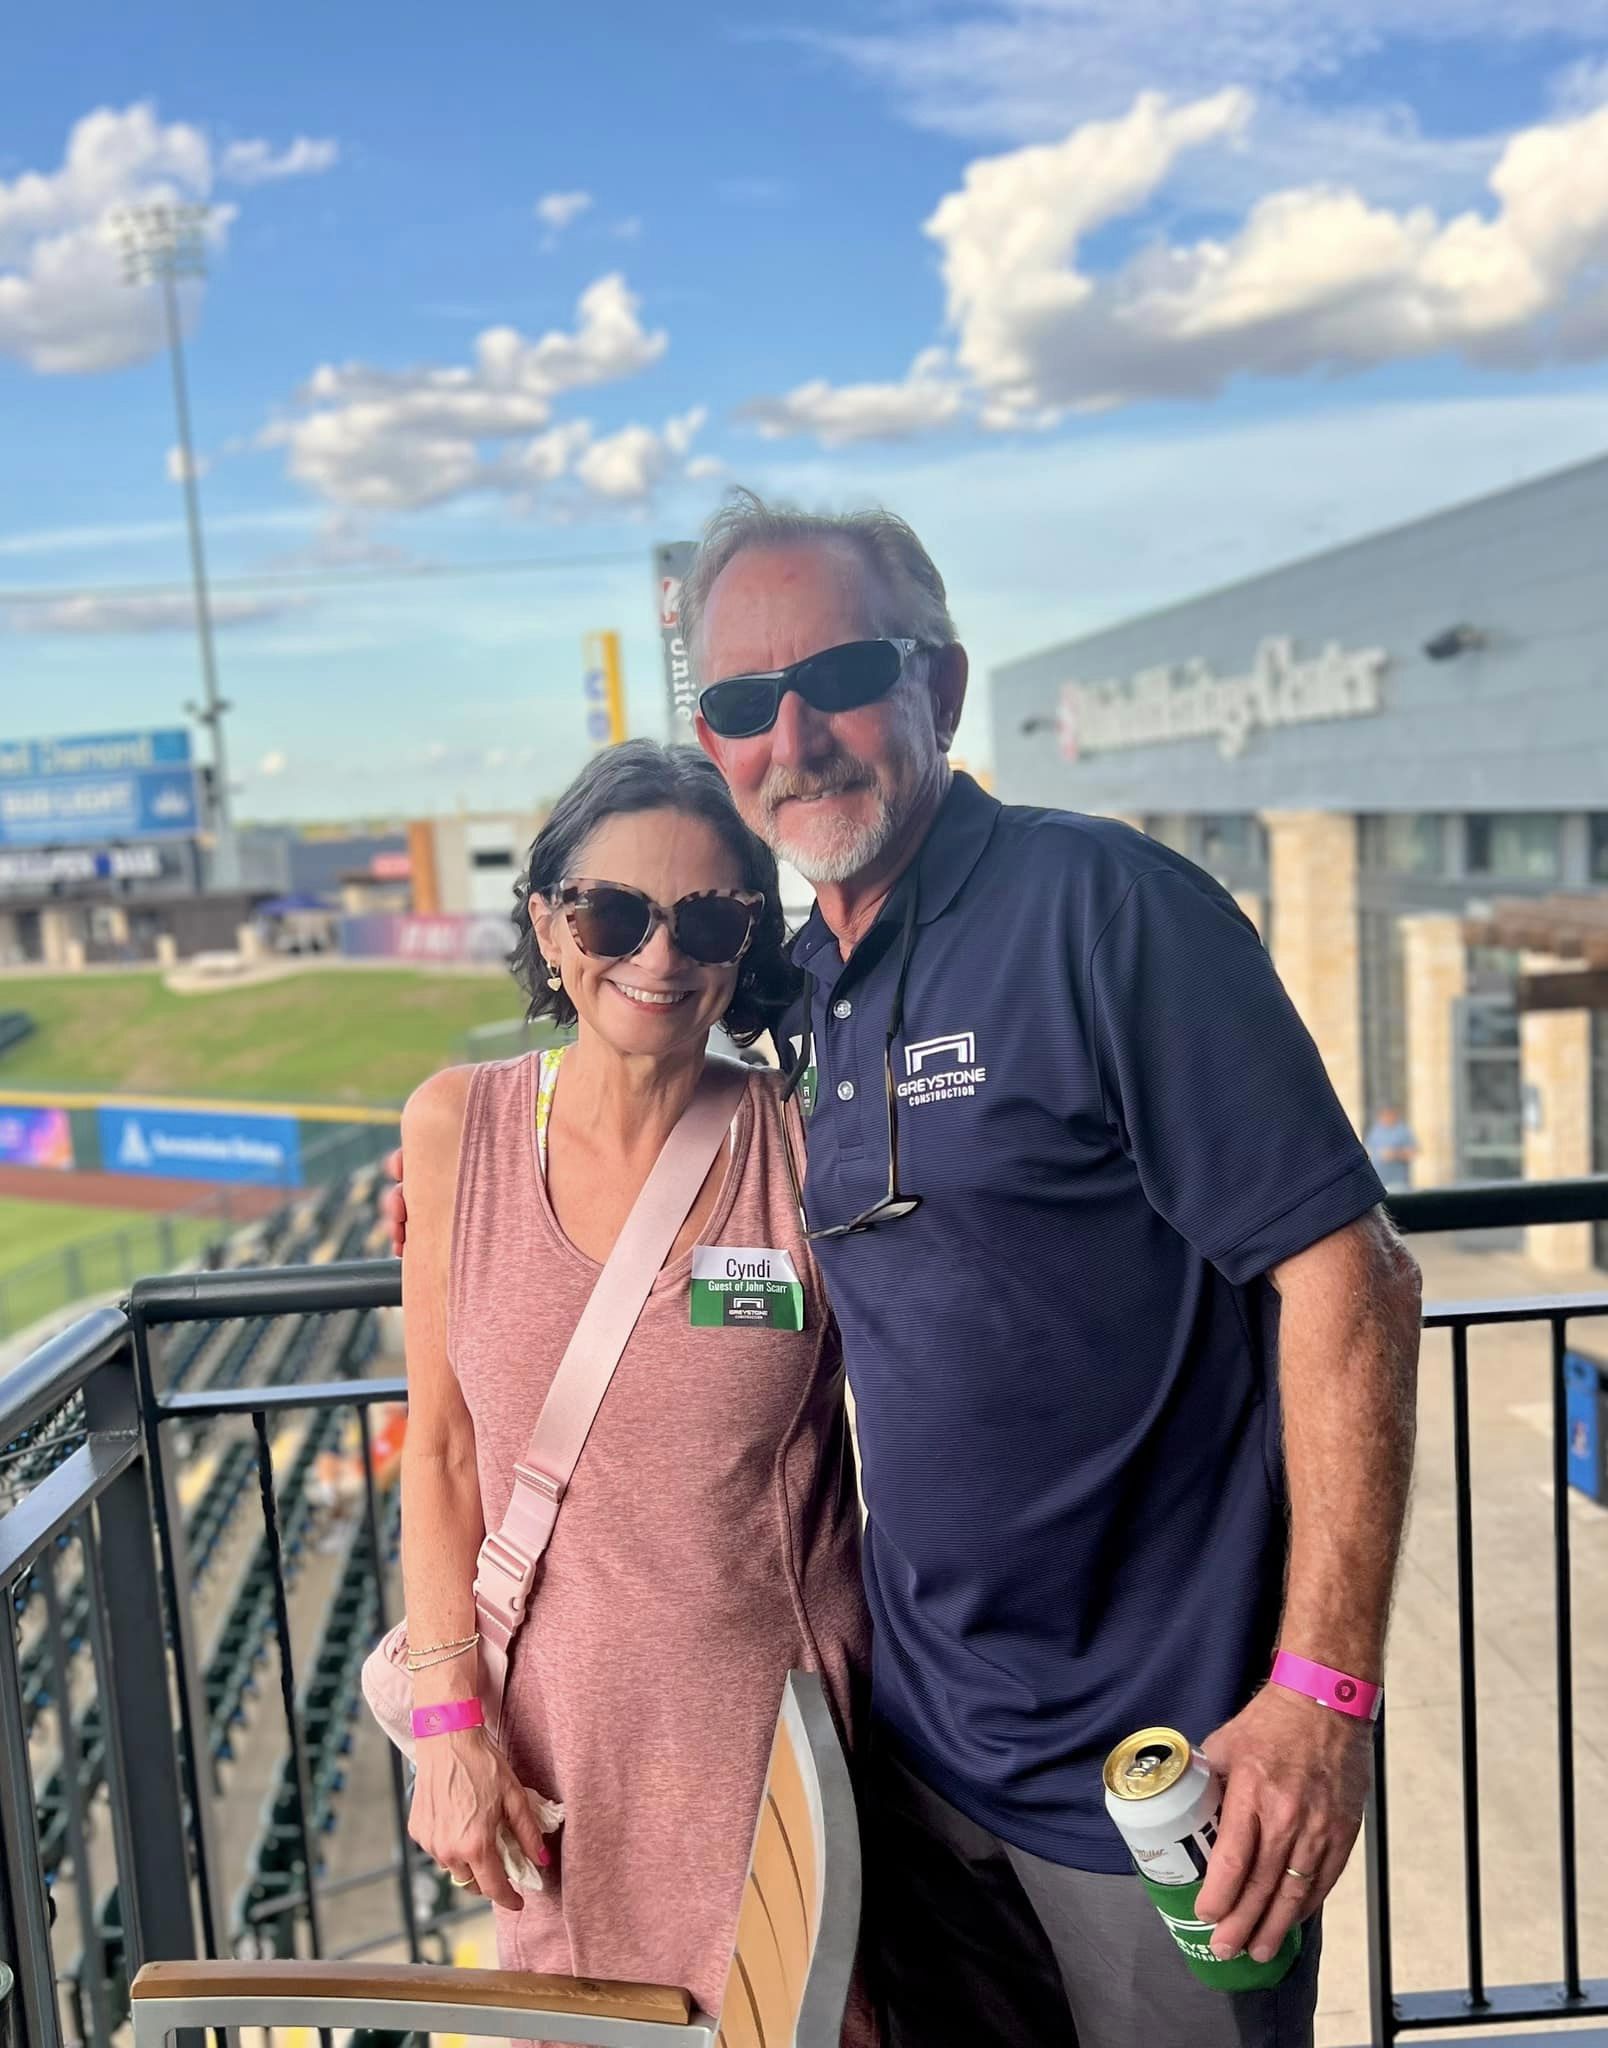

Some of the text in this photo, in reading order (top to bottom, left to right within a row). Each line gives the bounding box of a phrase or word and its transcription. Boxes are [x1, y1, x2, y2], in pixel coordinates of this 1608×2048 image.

[897, 1067, 986, 1096] GREYSTONE
[908, 1085, 975, 1107] CONSTRUCTION
[726, 1258, 770, 1280] Cyndi
[708, 1281, 787, 1294] Guest of John Scarr
